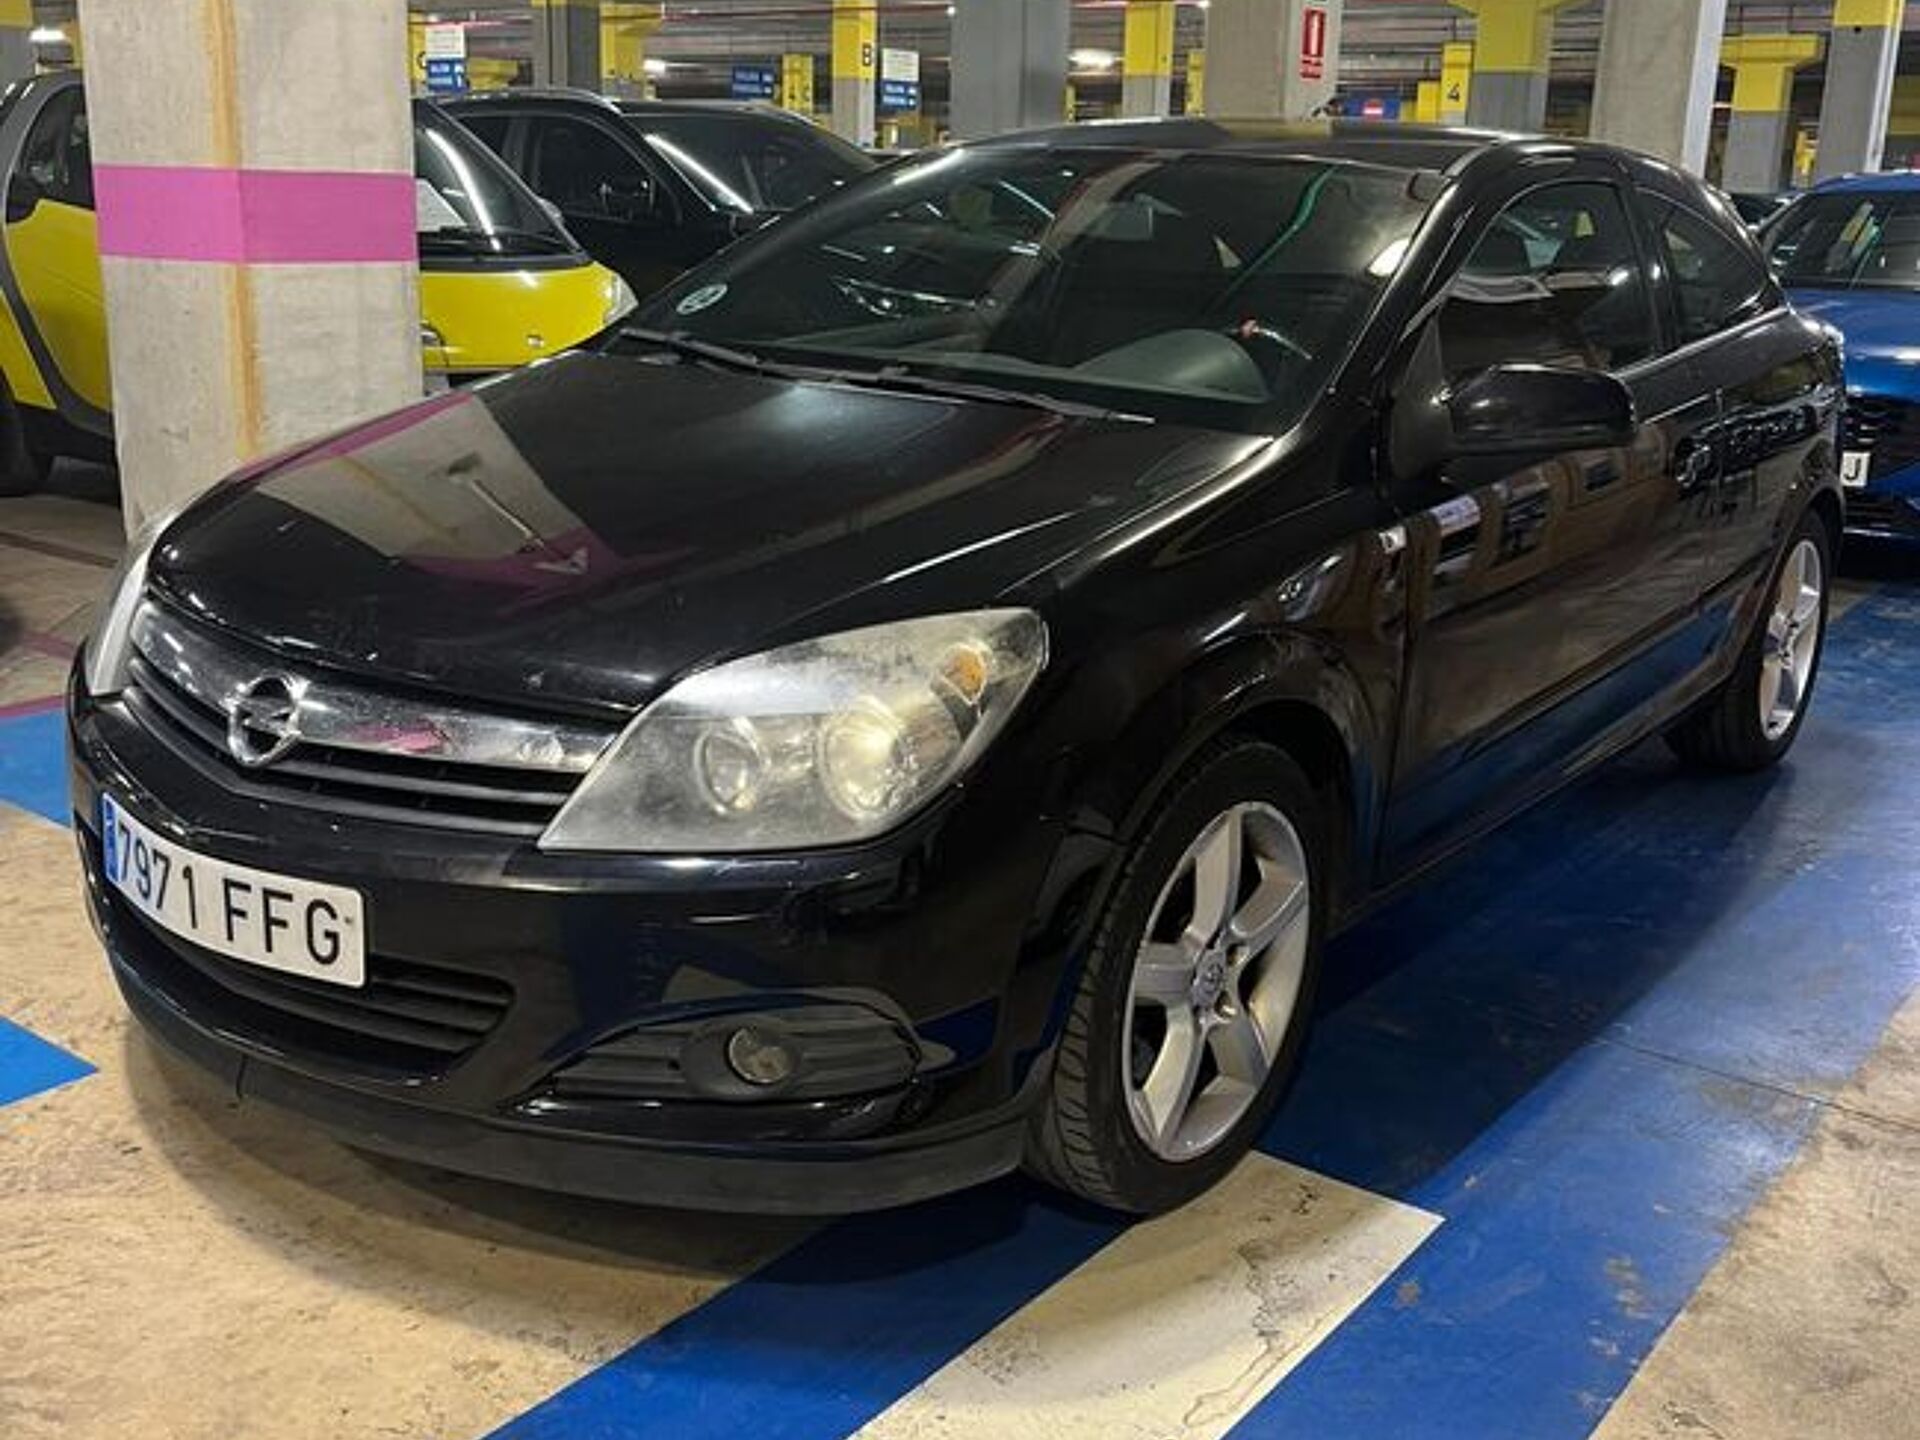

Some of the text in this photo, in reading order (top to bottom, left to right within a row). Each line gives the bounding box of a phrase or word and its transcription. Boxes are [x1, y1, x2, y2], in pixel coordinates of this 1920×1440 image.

[862, 43, 872, 67] B
[1447, 82, 1460, 102] 4
[118, 820, 341, 966] 7971 FFG
